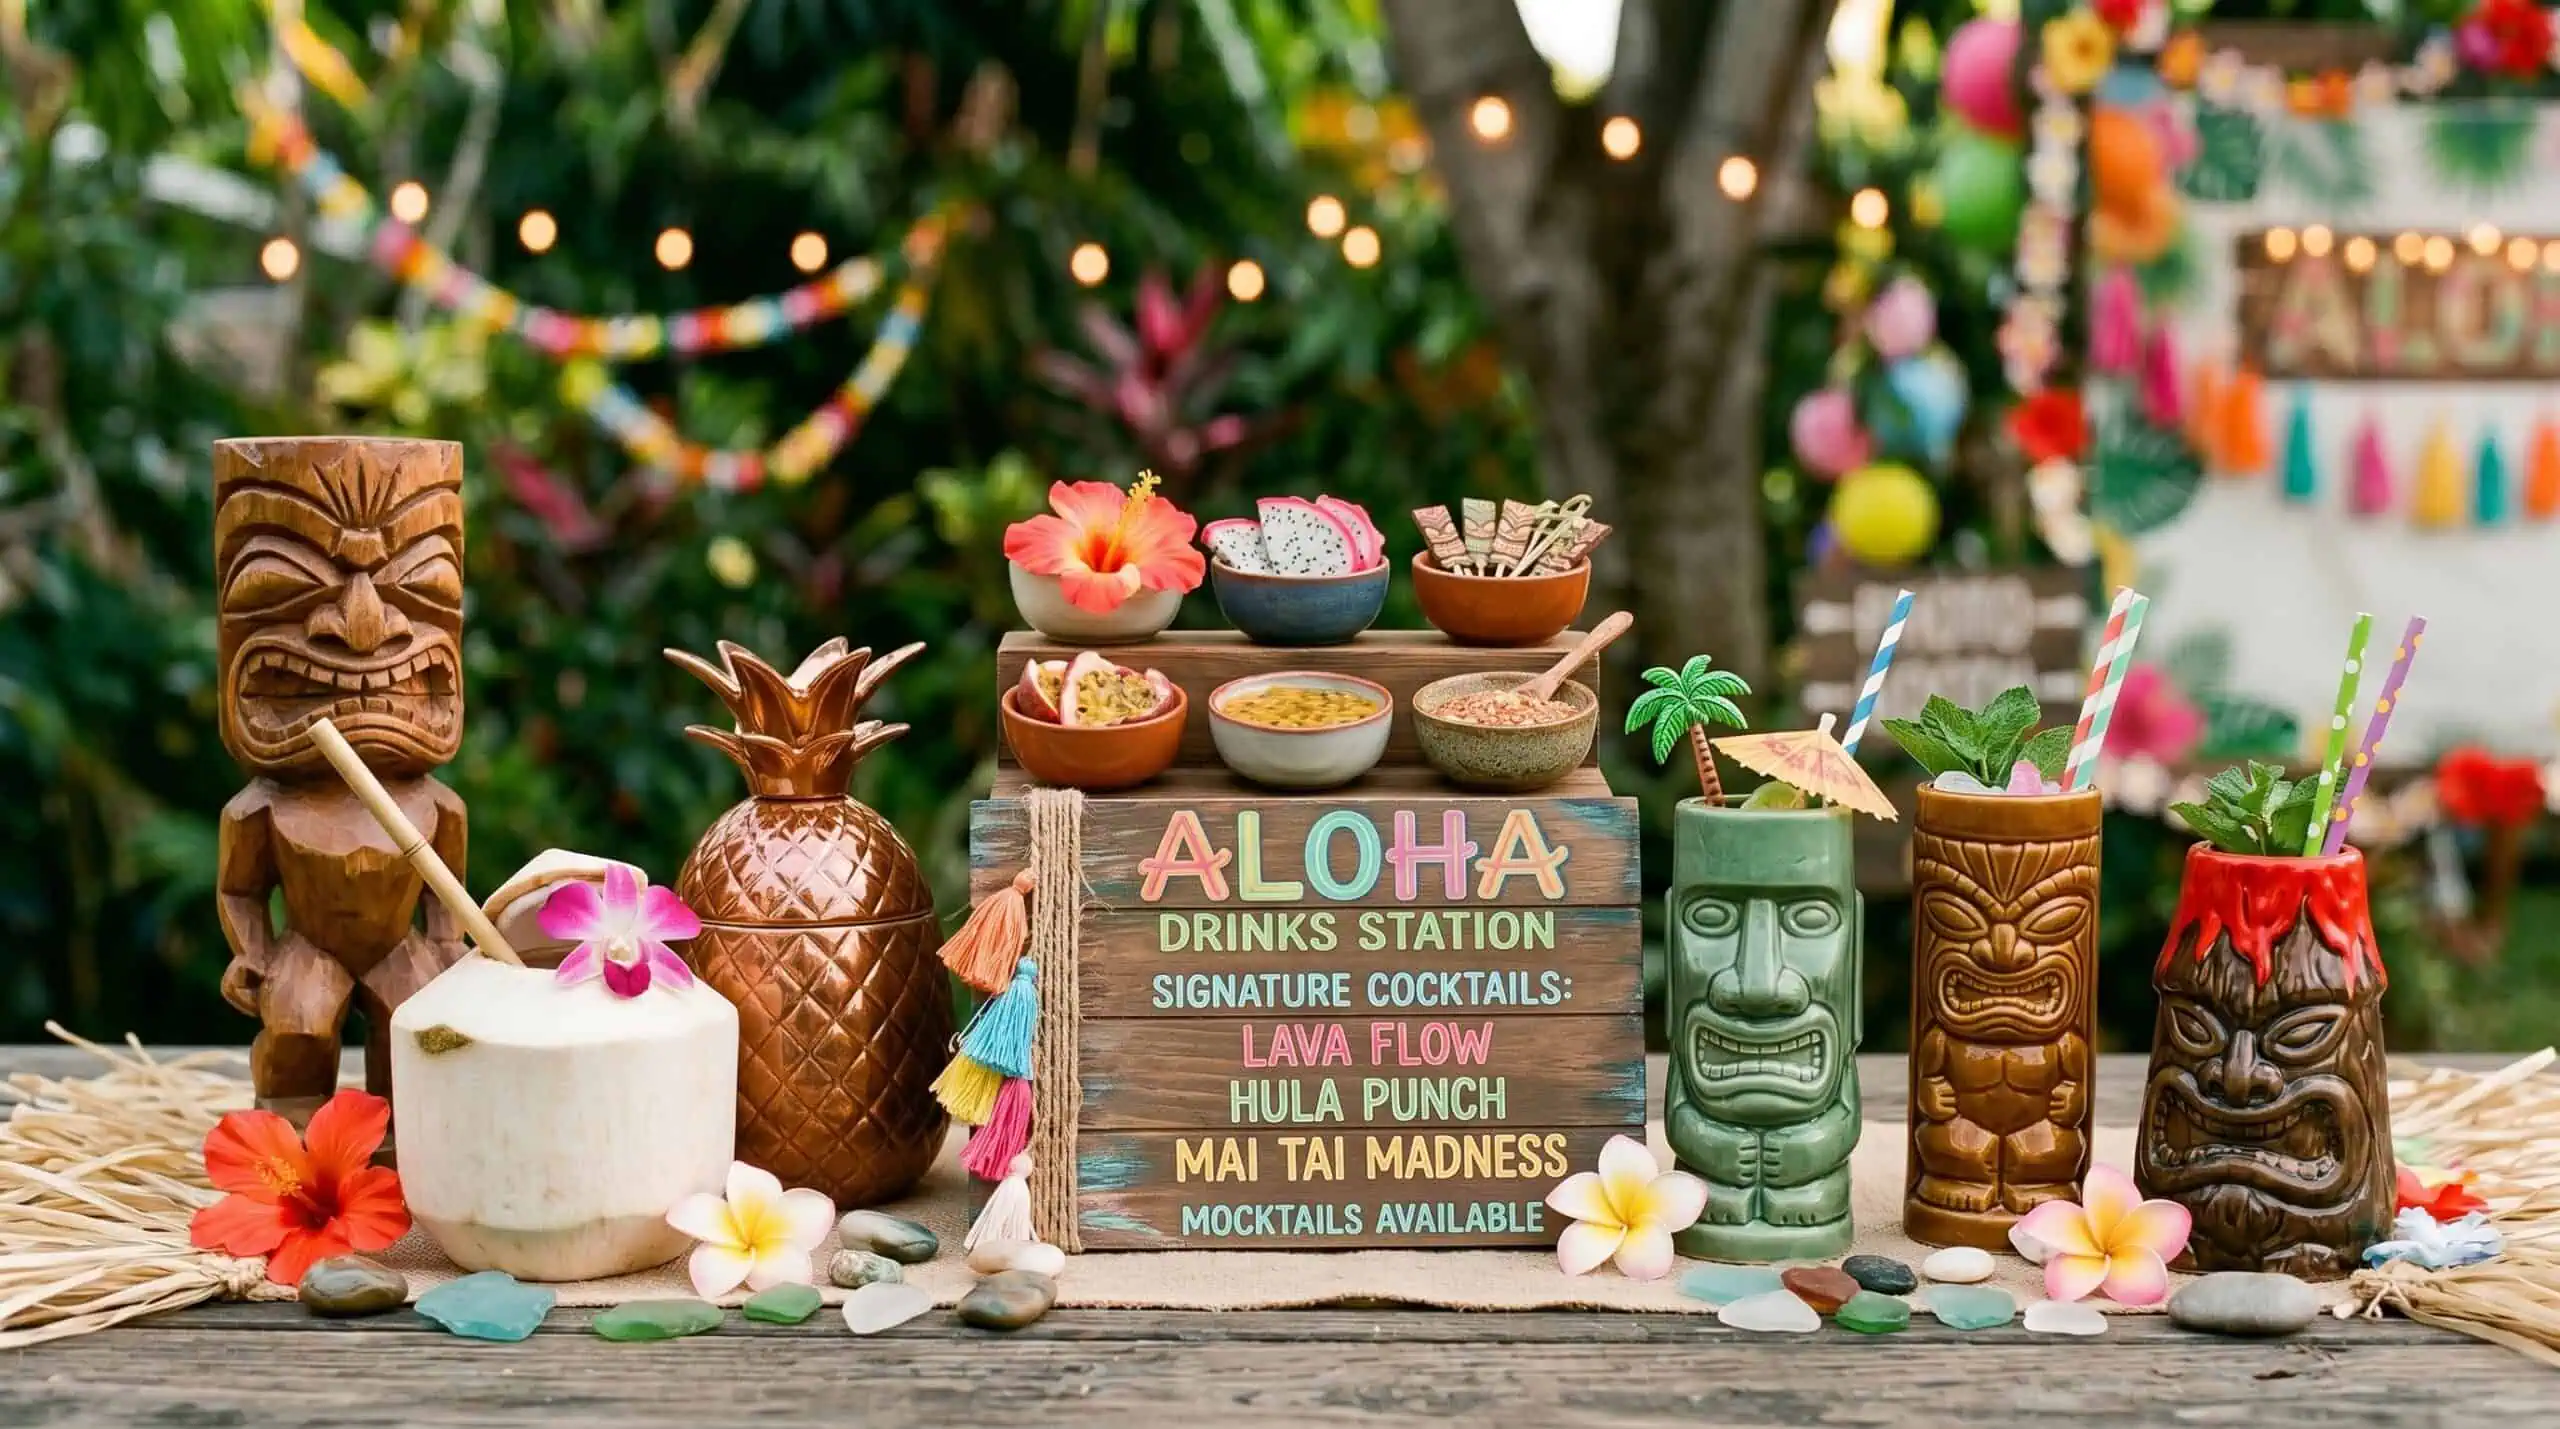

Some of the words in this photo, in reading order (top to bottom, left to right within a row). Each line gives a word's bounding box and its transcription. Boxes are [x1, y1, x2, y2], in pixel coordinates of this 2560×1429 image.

[1138, 809, 1569, 901] ALOHA
[1159, 912, 1338, 953] DRINKS
[1358, 911, 1556, 951] STATION
[1152, 973, 1350, 1009] SIGNATURE
[1366, 971, 1573, 1007] COCKTAILS:
[1241, 1023, 1352, 1068] LAVA
[1370, 1022, 1494, 1066] FLOW
[1229, 1078, 1345, 1123] HULA
[1363, 1077, 1507, 1121] PUNCH
[1175, 1137, 1259, 1183] MAI
[1278, 1136, 1346, 1181] TAI
[1366, 1134, 1568, 1180] MADNESS
[1180, 1204, 1363, 1237] MOCKTAILS
[1374, 1201, 1545, 1235] AVAILABLE
